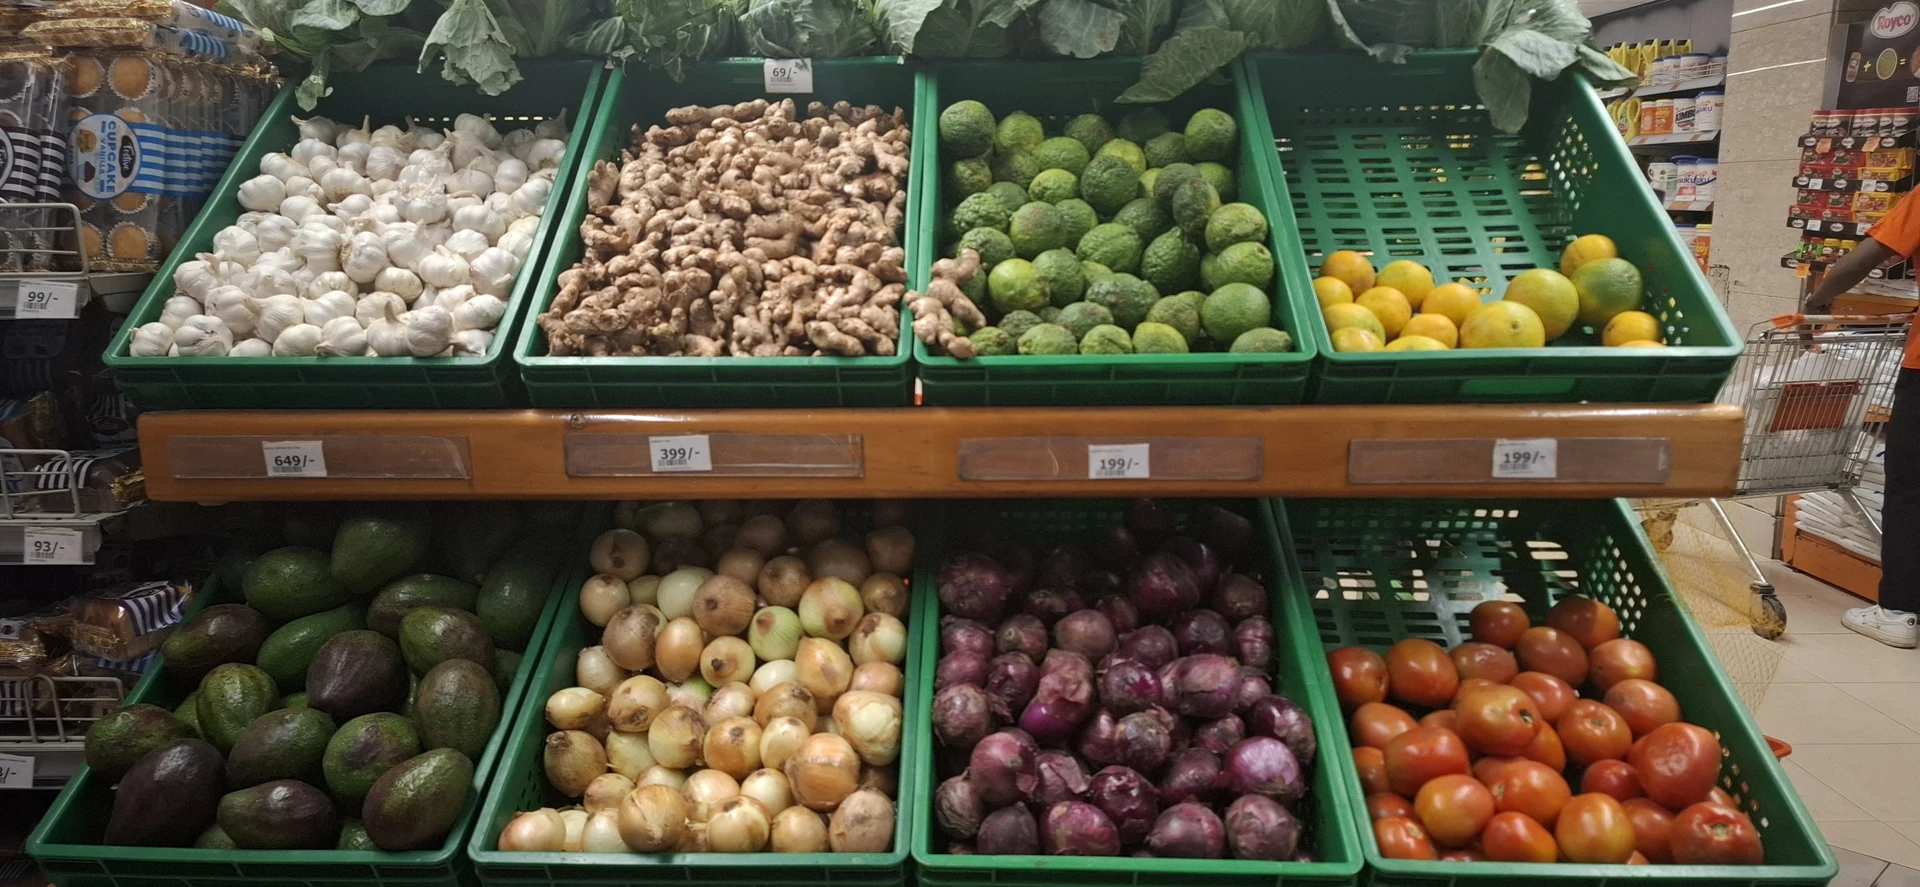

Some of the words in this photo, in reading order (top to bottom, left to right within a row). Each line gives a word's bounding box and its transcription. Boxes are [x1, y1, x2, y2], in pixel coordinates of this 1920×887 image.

[1877, 14, 1912, 32] Royco
[773, 67, 798, 79] 69/-
[107, 121, 116, 193] CUPCAKE
[122, 142, 135, 171] Festive
[28, 291, 58, 305] 99/-
[660, 447, 700, 460] 399/-
[1504, 451, 1546, 464] 199/-
[274, 455, 315, 468] 649/-
[1101, 458, 1139, 471] 199/-
[34, 541, 65, 555] 93/-
